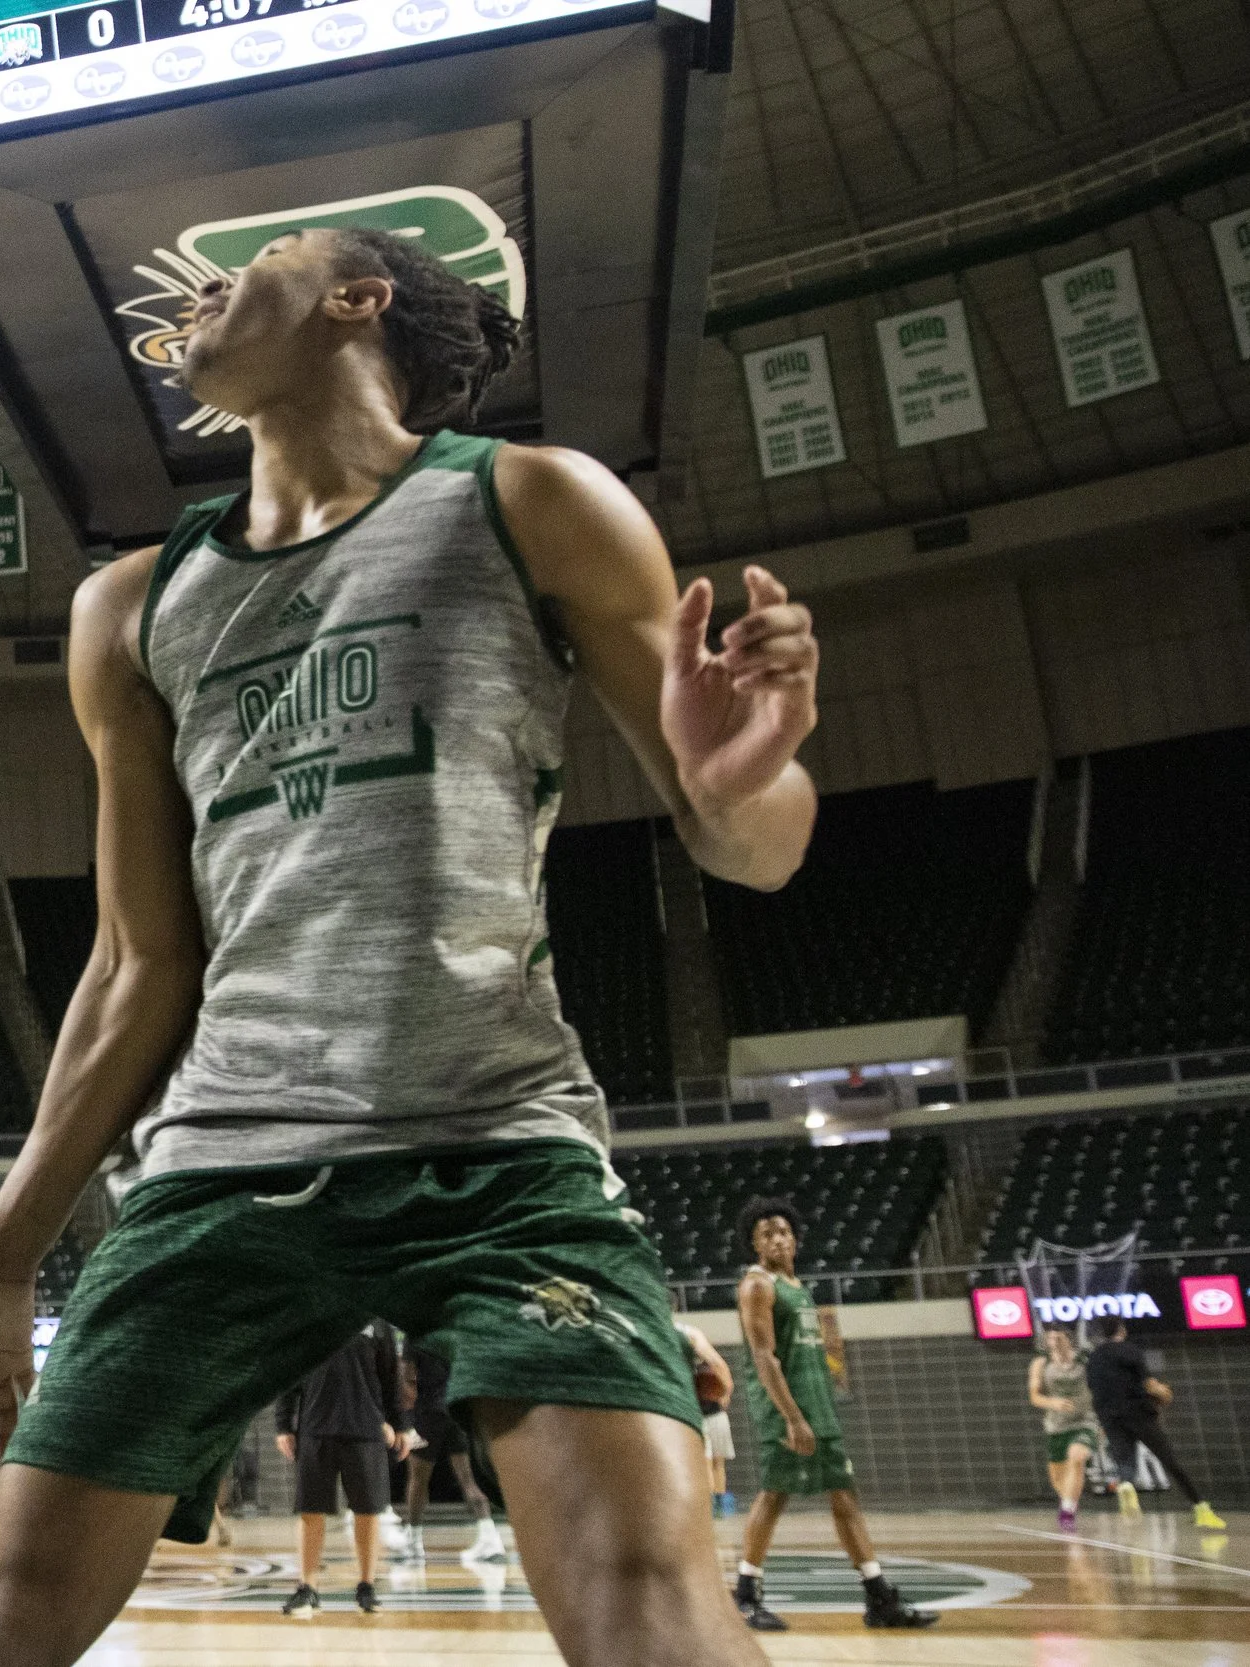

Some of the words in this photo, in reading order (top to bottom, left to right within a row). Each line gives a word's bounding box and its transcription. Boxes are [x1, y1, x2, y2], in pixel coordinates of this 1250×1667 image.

[88, 10, 115, 47] 0
[1063, 267, 1117, 304] OHIO
[898, 316, 947, 348] OHIO
[764, 350, 810, 382] OHIO
[237, 641, 378, 740] OHIO
[1034, 1293, 1161, 1322] TOYOTA
